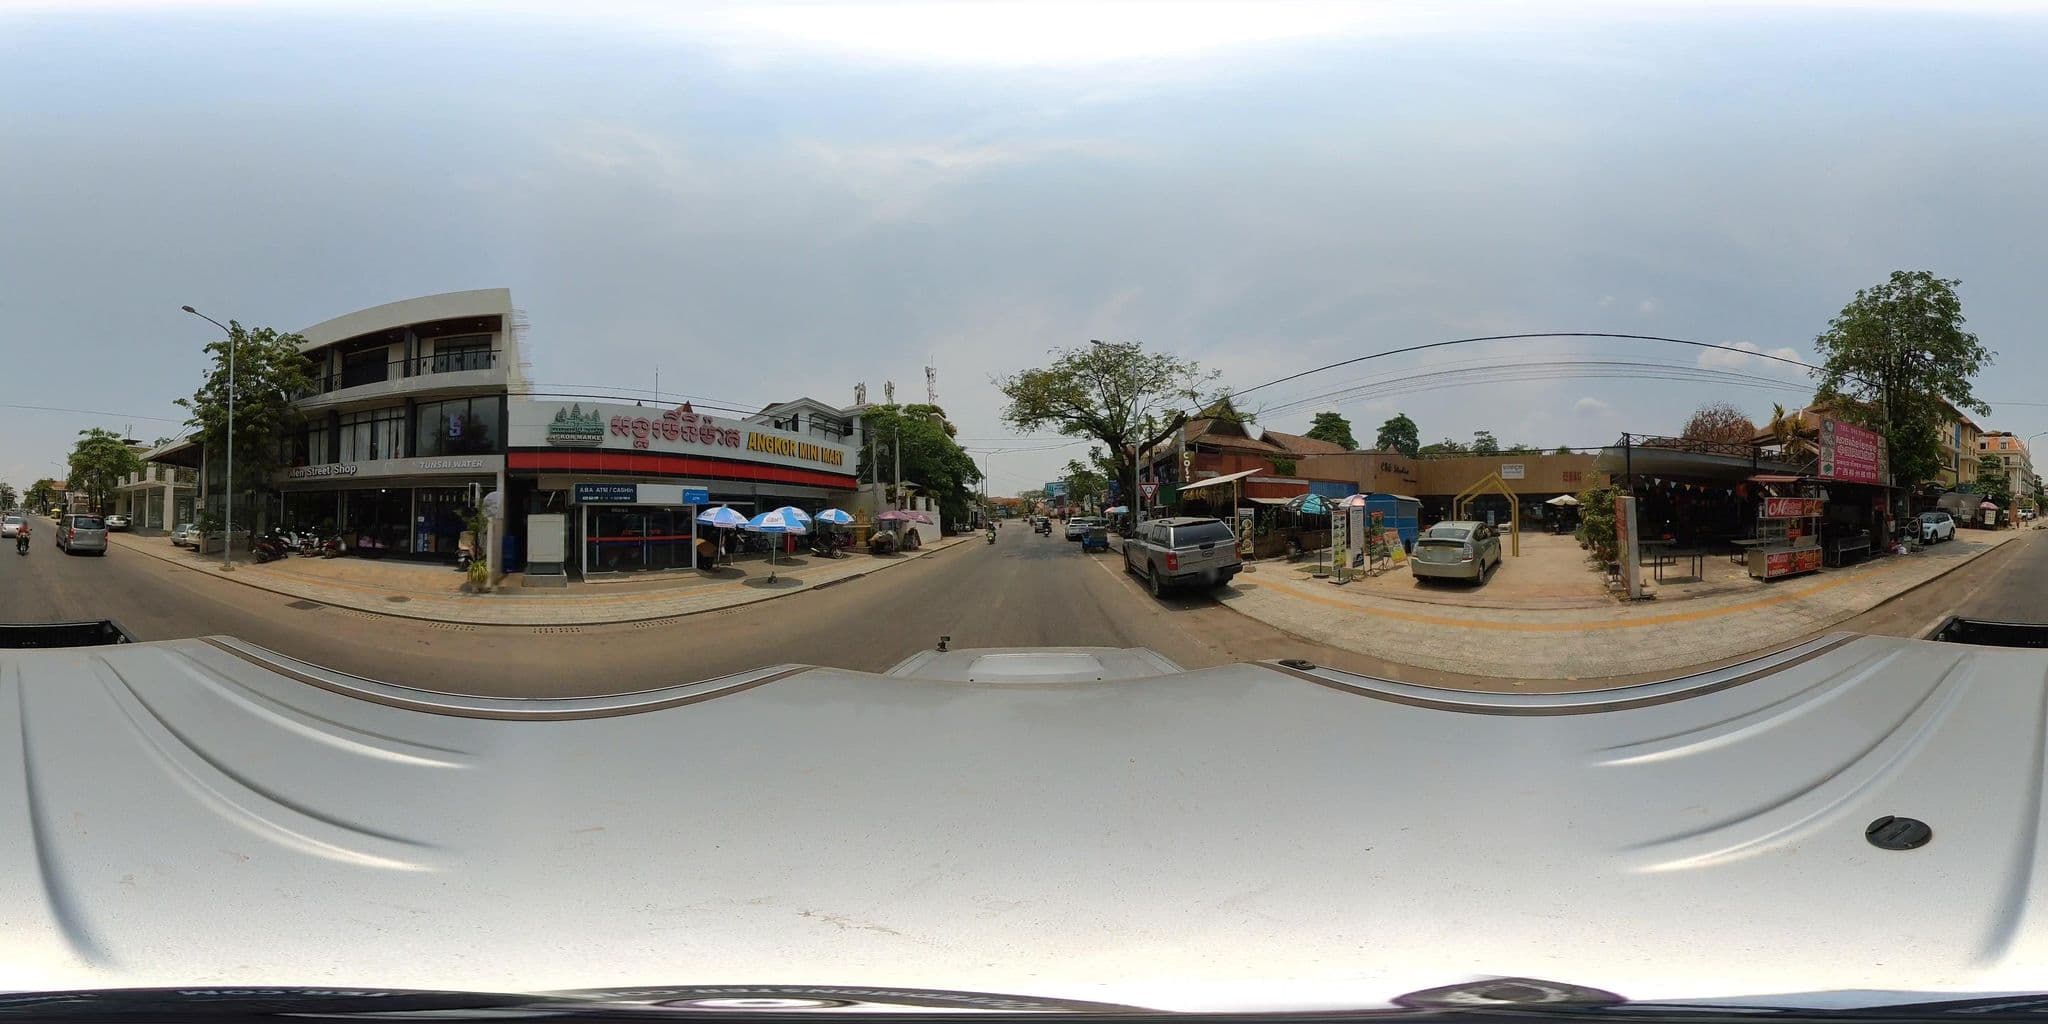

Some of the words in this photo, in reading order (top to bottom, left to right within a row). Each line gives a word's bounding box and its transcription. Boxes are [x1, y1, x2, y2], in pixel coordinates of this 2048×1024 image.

[747, 431, 797, 458] ANGKOR
[798, 441, 819, 461] MINI
[821, 447, 844, 466] MART
[306, 466, 331, 478] Street
[333, 463, 358, 477] Shop
